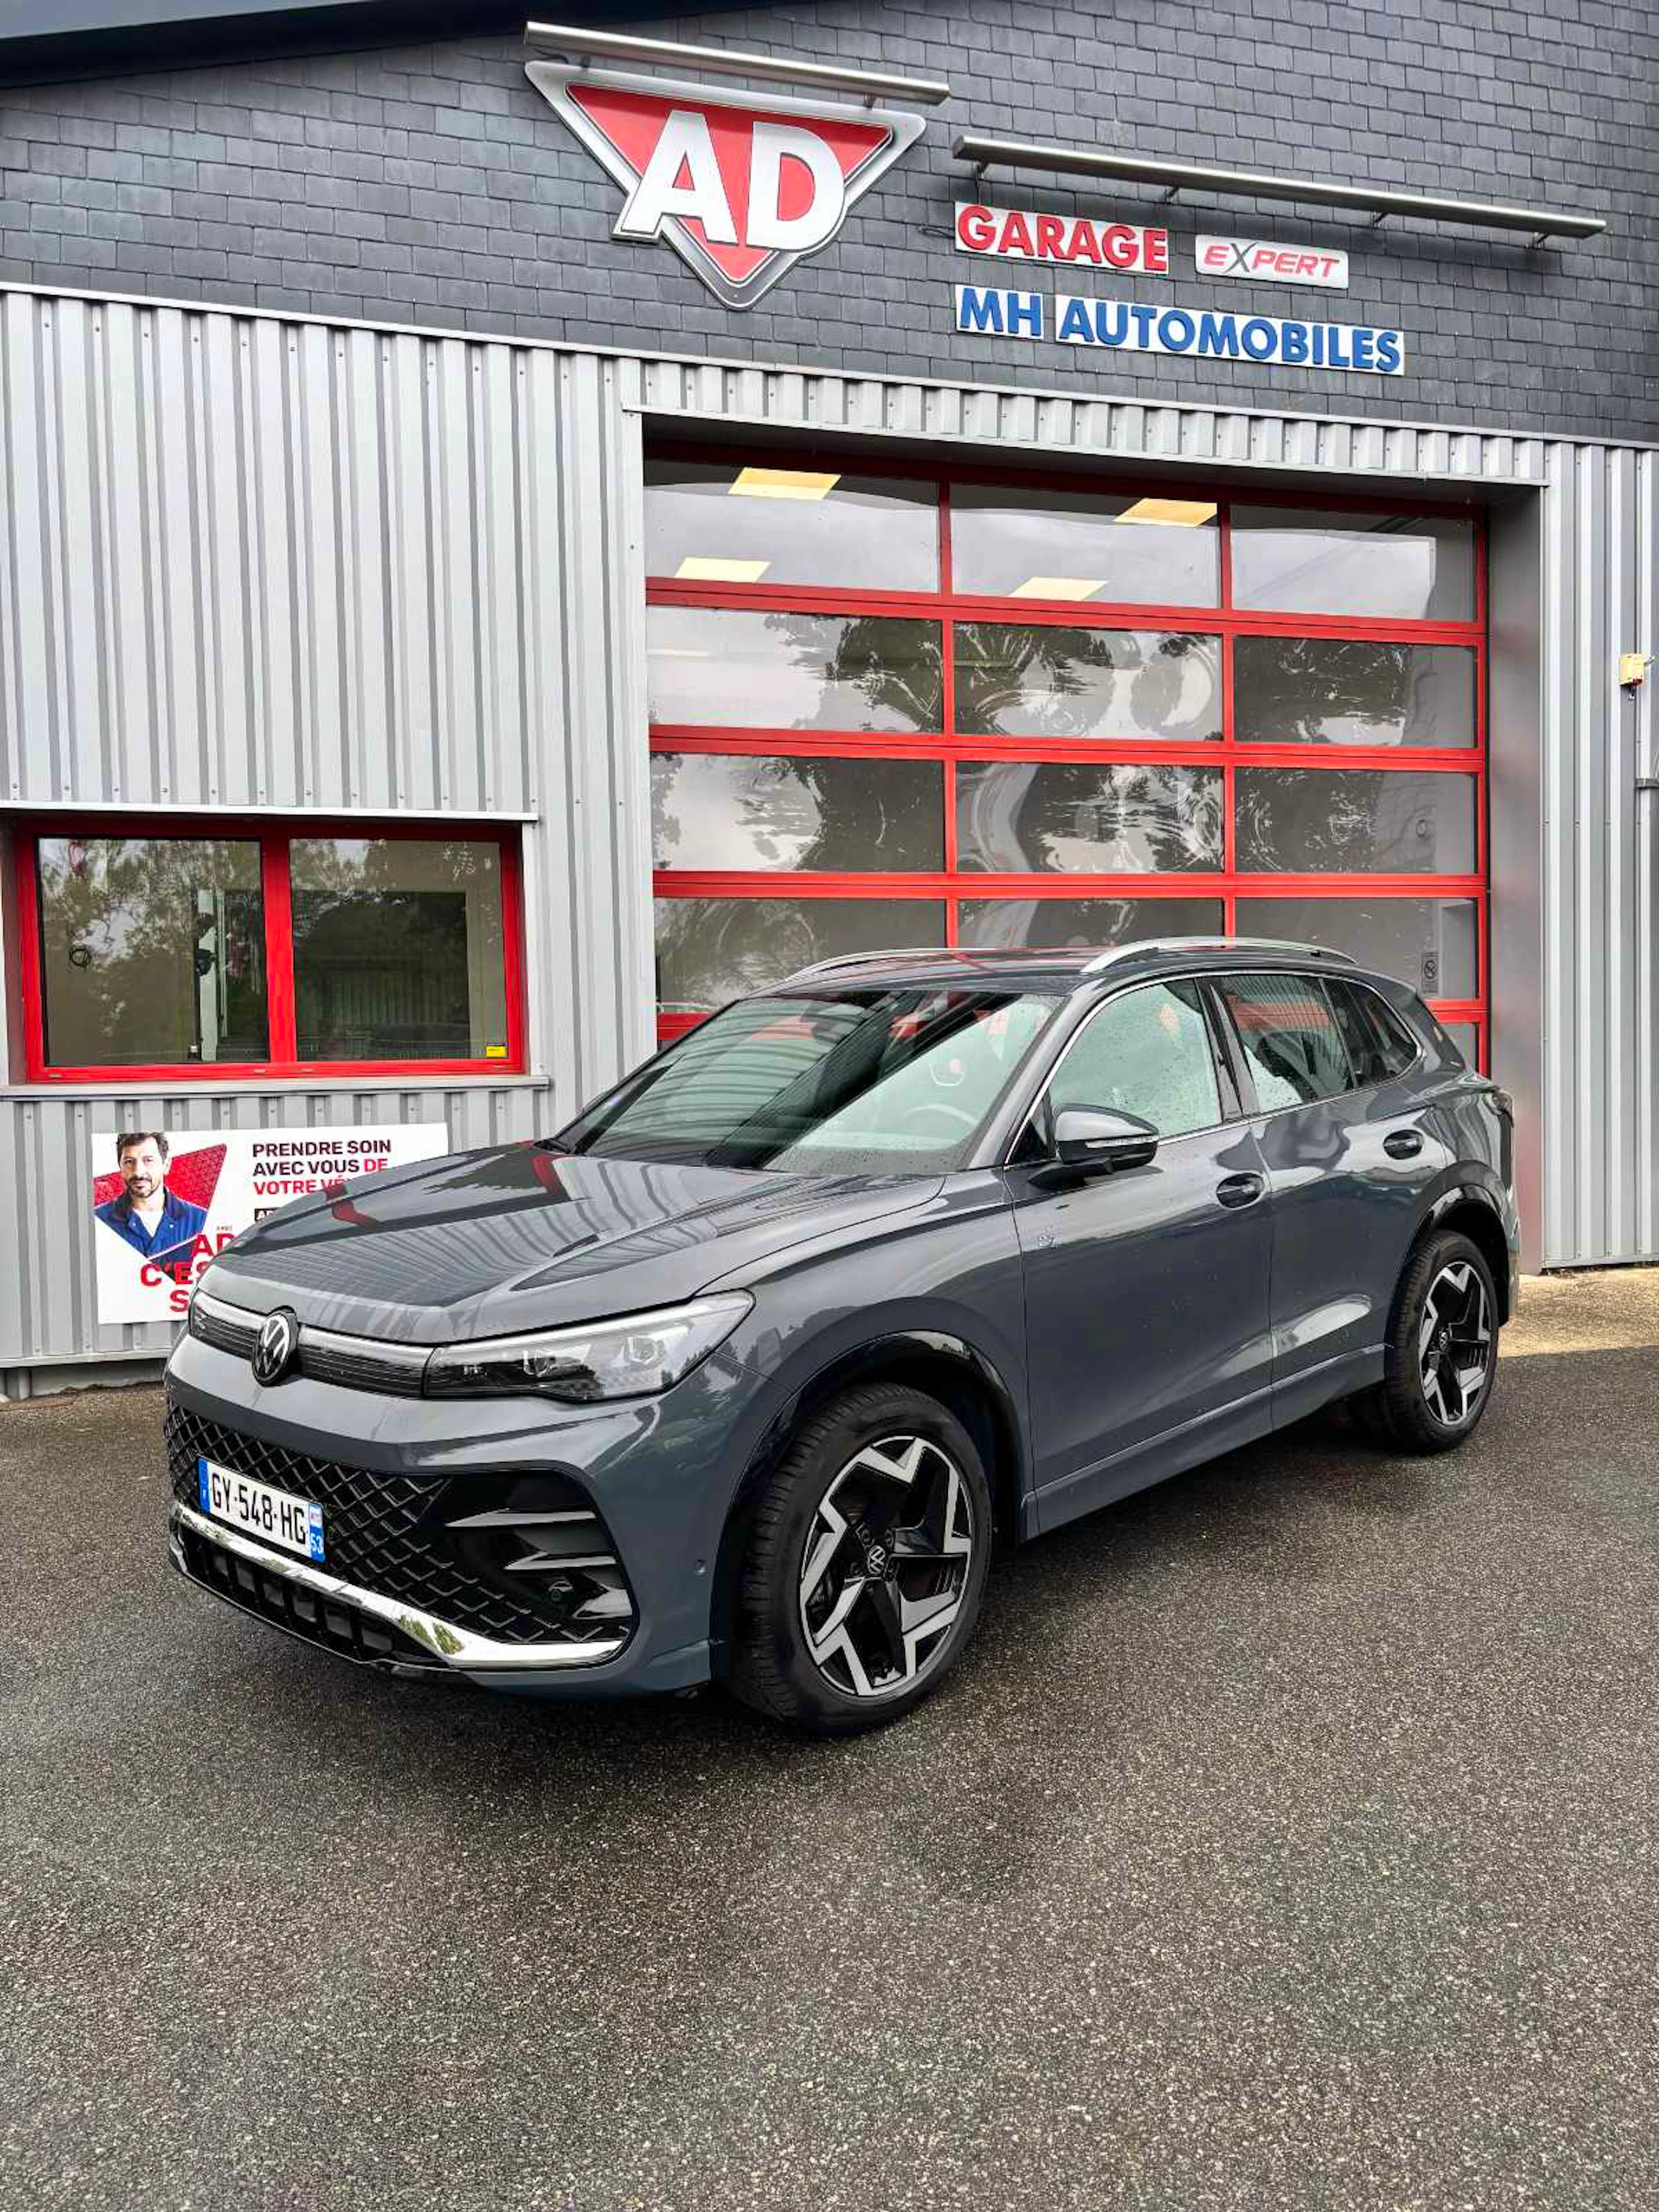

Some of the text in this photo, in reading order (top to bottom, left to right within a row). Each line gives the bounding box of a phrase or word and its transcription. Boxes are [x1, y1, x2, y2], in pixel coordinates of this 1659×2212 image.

[613, 109, 846, 252] AD
[957, 205, 1168, 272] GARAGE
[1203, 241, 1340, 278] EXPERT
[959, 287, 1402, 373] MH AUTOMOBILES
[253, 1139, 391, 1157] PRENDRE SOIN
[253, 1158, 388, 1176] AVEC VOUS DE
[253, 1179, 316, 1195] VOTRE
[213, 1472, 306, 1545] GY-548-HG
[310, 1532, 323, 1554] 53
